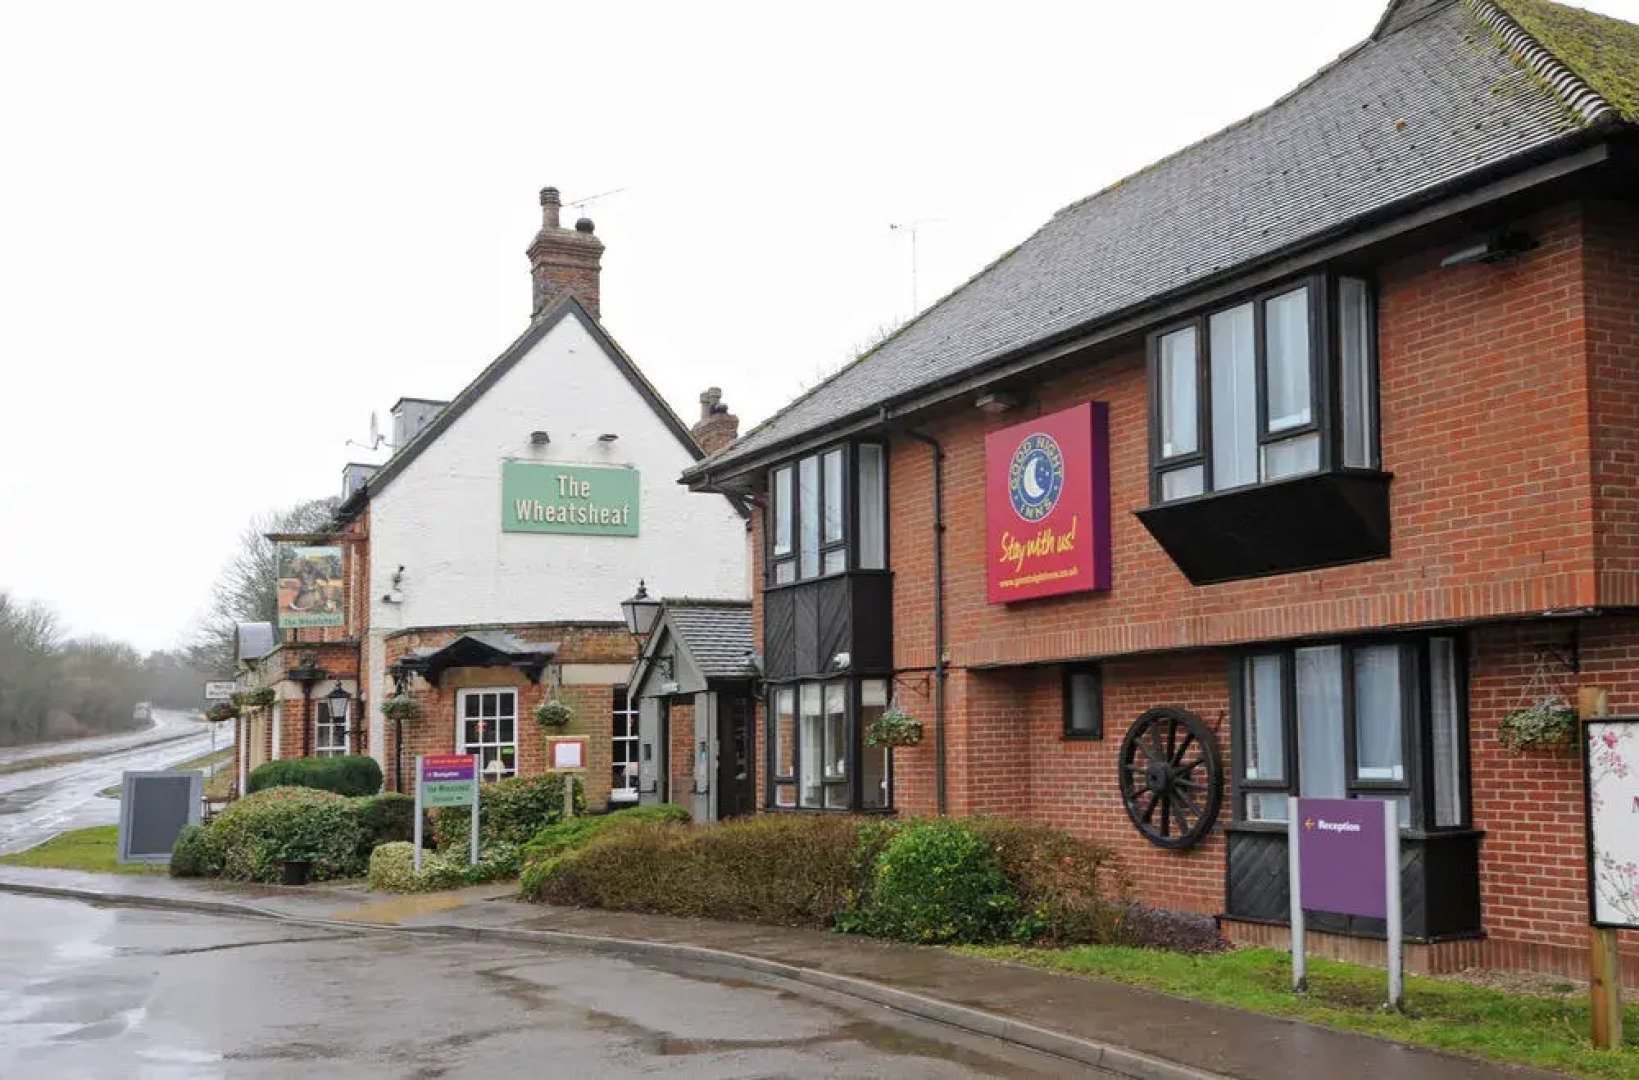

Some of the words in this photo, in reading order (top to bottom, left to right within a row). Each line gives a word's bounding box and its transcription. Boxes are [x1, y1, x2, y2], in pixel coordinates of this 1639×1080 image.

[1010, 440, 1032, 491] GOOD
[1036, 436, 1063, 478] NIGHT
[556, 474, 591, 498] The
[515, 499, 630, 526] Wheatsheaf
[1020, 499, 1053, 518] INNS
[999, 531, 1026, 573] Stay
[1027, 527, 1055, 558] with
[1057, 516, 1078, 553] us!
[1317, 819, 1361, 834] Reception
